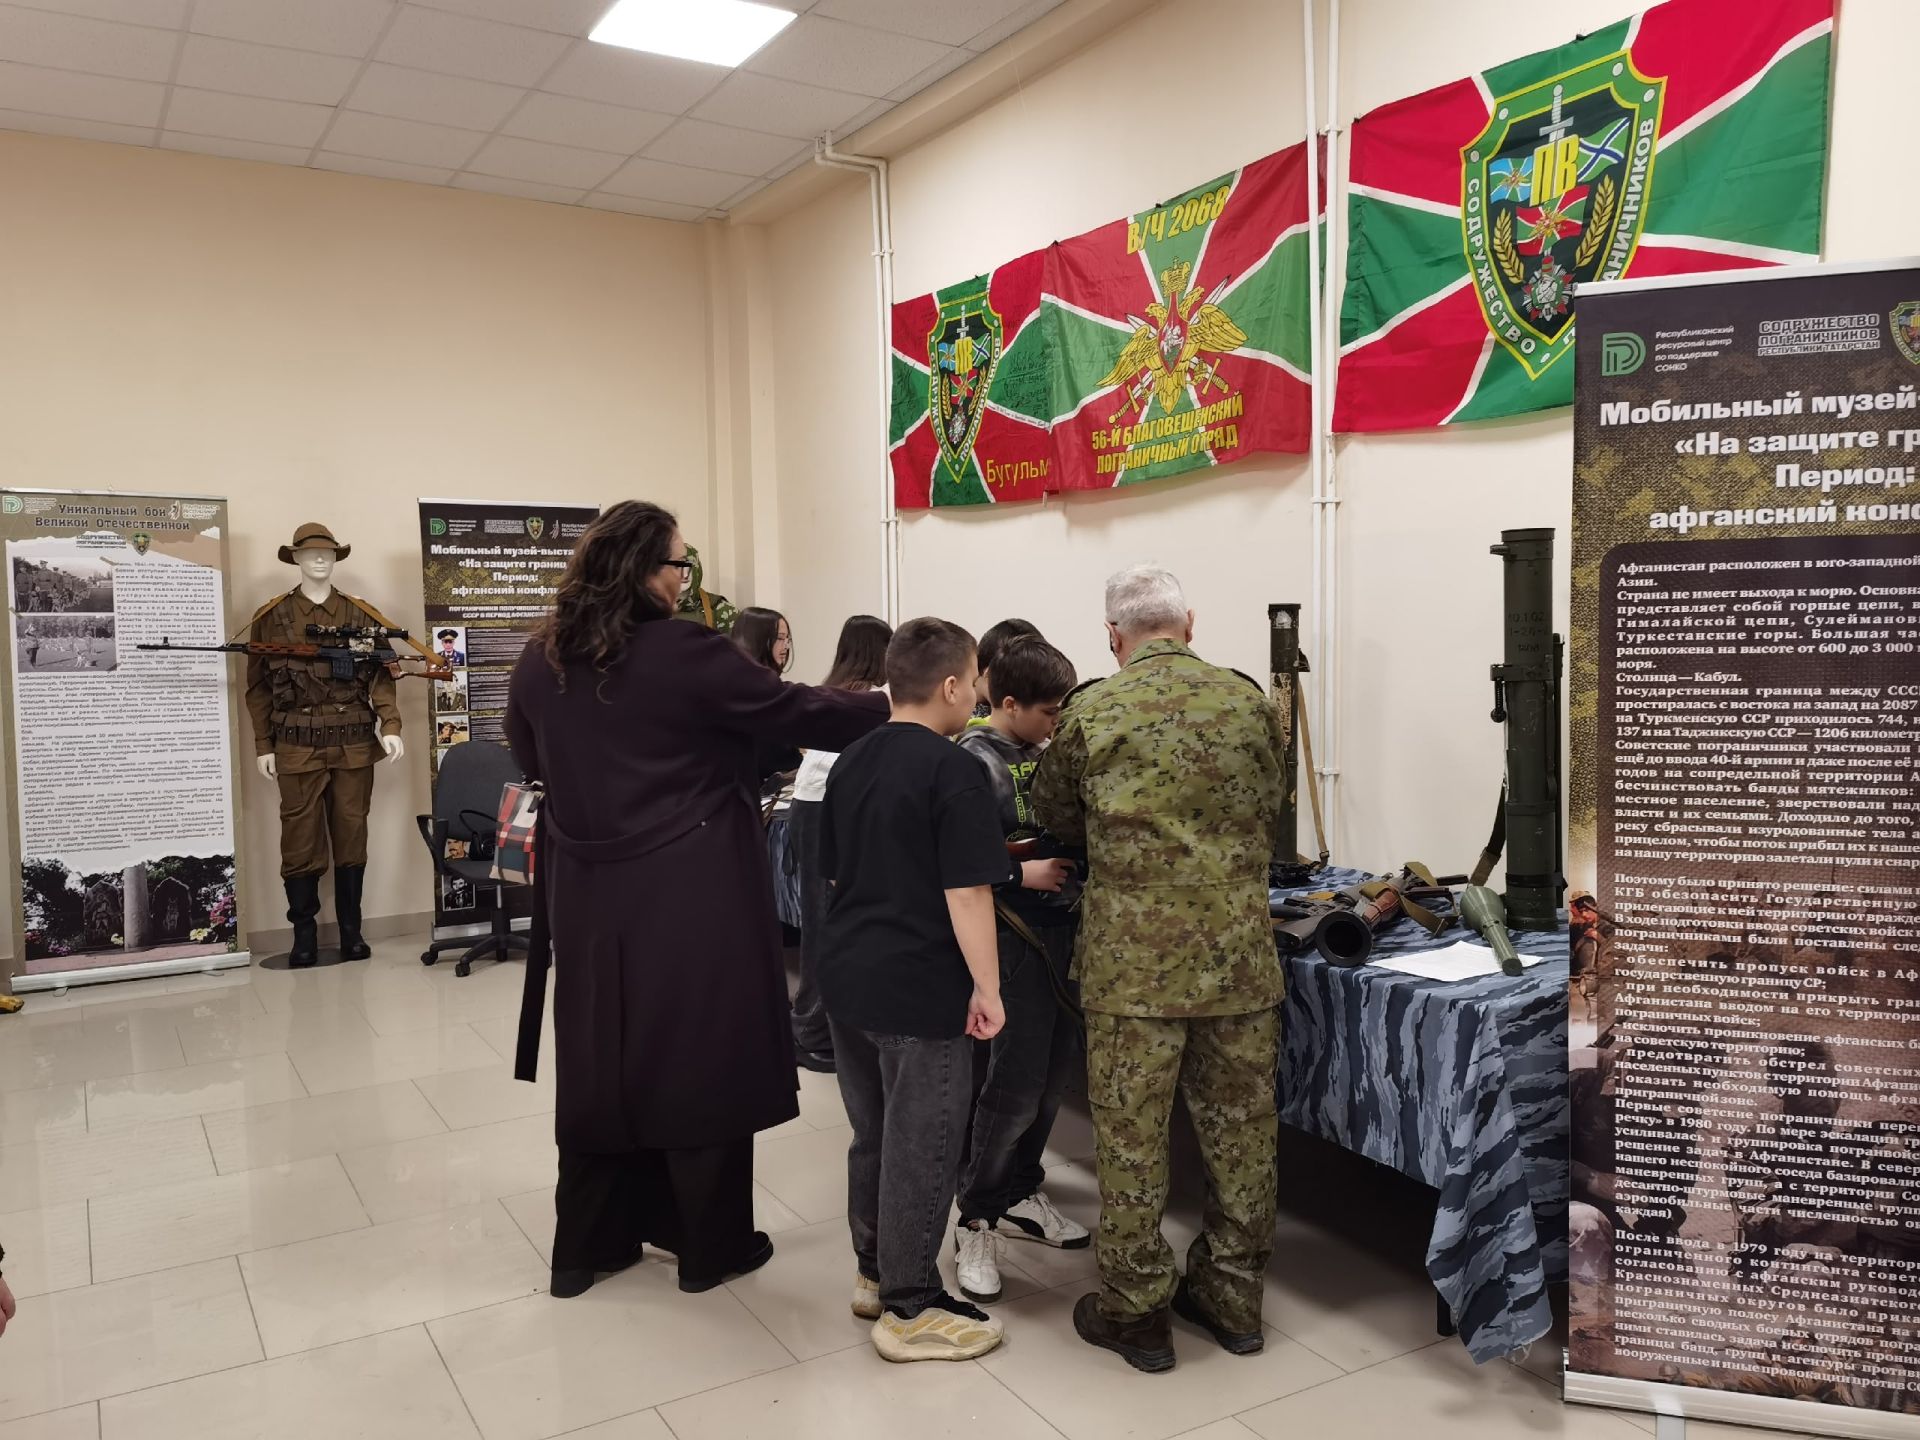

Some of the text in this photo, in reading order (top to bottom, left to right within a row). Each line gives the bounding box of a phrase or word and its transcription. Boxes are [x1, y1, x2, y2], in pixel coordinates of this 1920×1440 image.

[1530, 134, 1580, 207] ПВ
[1602, 118, 1654, 281] АНИЧНИКОВ
[1127, 185, 1231, 255] В/Ч 2068
[1466, 177, 1537, 355] СОДРУЖЕСТВО
[1655, 325, 1734, 338] Республиканский
[1759, 313, 1880, 334] СОДРУЖЕСТВО
[1655, 338, 1732, 351] ресурсный центр
[1759, 328, 1880, 347] ПОГРАНИЧНИКОВ
[1668, 351, 1719, 360] поддержке
[1758, 340, 1880, 356] РЕСПУБЛИКИ ТАТАРСТАН
[1655, 363, 1687, 372] СОНКО
[1600, 391, 1802, 426] Мобильный
[1092, 391, 1244, 449] 56-Й БЛАГОВЕЩЕНСКИЙ
[1097, 424, 1239, 474] ПОГРАНИЧНЫЙ ОТРЯД
[1675, 431, 1740, 455] «На
[1748, 429, 1879, 454] защите
[1775, 464, 1915, 492] Период:
[1649, 500, 1837, 534] афганский
[430, 544, 501, 557] Мобильный
[458, 558, 481, 569] «На
[483, 560, 524, 570] защите
[1618, 561, 1705, 575] Афганистан
[1709, 559, 1800, 573] расположен
[1804, 559, 1812, 568] в
[492, 572, 539, 584] Период:
[1617, 575, 1657, 586] Азии.
[452, 585, 514, 598] афганский
[1617, 589, 1668, 602] Страна
[1672, 590, 1689, 599] не
[1693, 589, 1737, 599] имеет
[1740, 588, 1794, 598] выхода
[1798, 588, 1807, 597] к
[1810, 587, 1856, 599] морю.
[1617, 614, 1920, 627] Гималайской цепи, Сулейманов
[1617, 628, 1889, 642] Туркестанские горы. Большая
[1617, 641, 1913, 657] расположена на высоте от 600 до 3 000
[1617, 684, 1920, 697] Государственная граница между ССС
[1616, 711, 1907, 726] на Туркменскую ССР приходилось 744,
[1615, 738, 1910, 754] Советские пограничники участвовали
[1616, 768, 1903, 783] годов на сопредельной территории
[1615, 779, 1913, 795] бесчинствовать банды мятежников:
[1616, 795, 1677, 805] местное
[1684, 796, 1769, 807] население,
[1777, 798, 1884, 810] зверствовали
[1615, 808, 1914, 824] власти и их семьями. Доходило до того,
[1615, 821, 1905, 838] реку сбрасывали изуродованные тела
